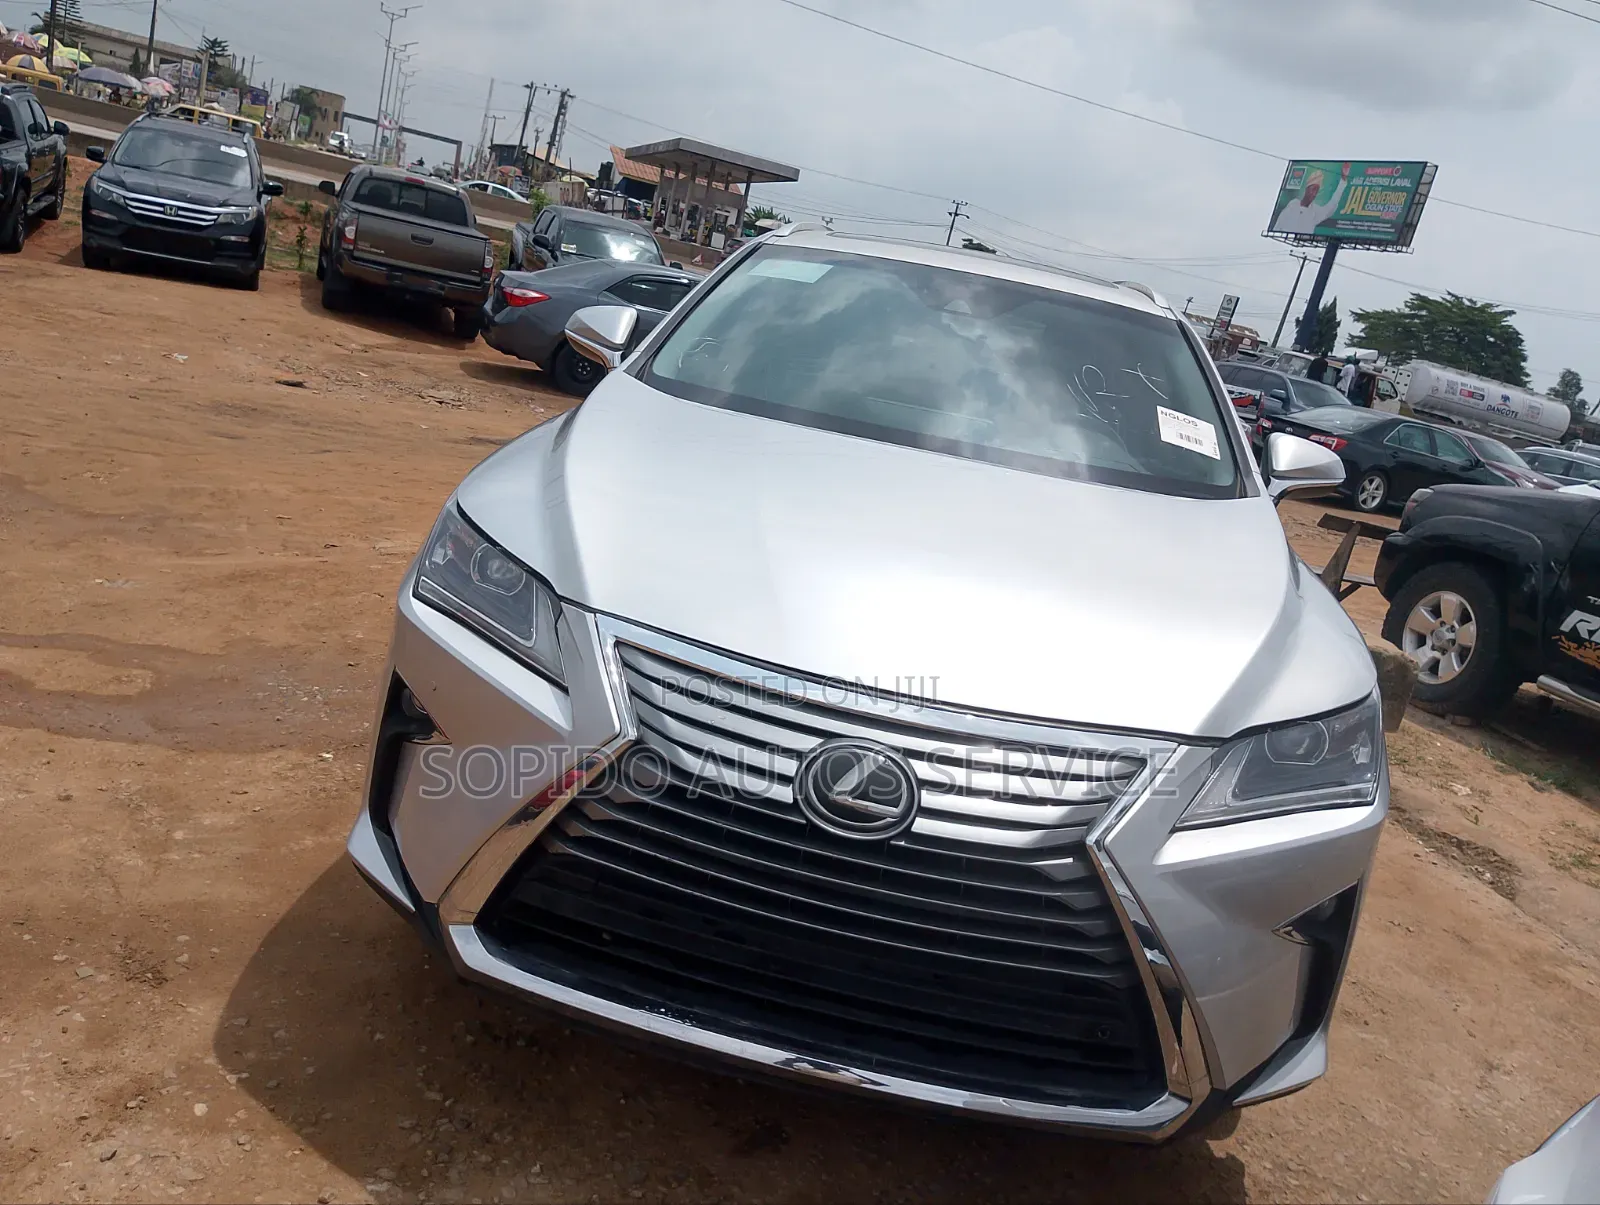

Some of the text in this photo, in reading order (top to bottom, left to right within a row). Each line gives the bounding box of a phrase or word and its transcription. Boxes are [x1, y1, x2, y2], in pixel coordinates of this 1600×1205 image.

[1340, 185, 1382, 217] JAL
[1367, 191, 1407, 205] GOVERNOR
[1382, 204, 1404, 213] STATE
[1486, 404, 1519, 419] DANGOTE
